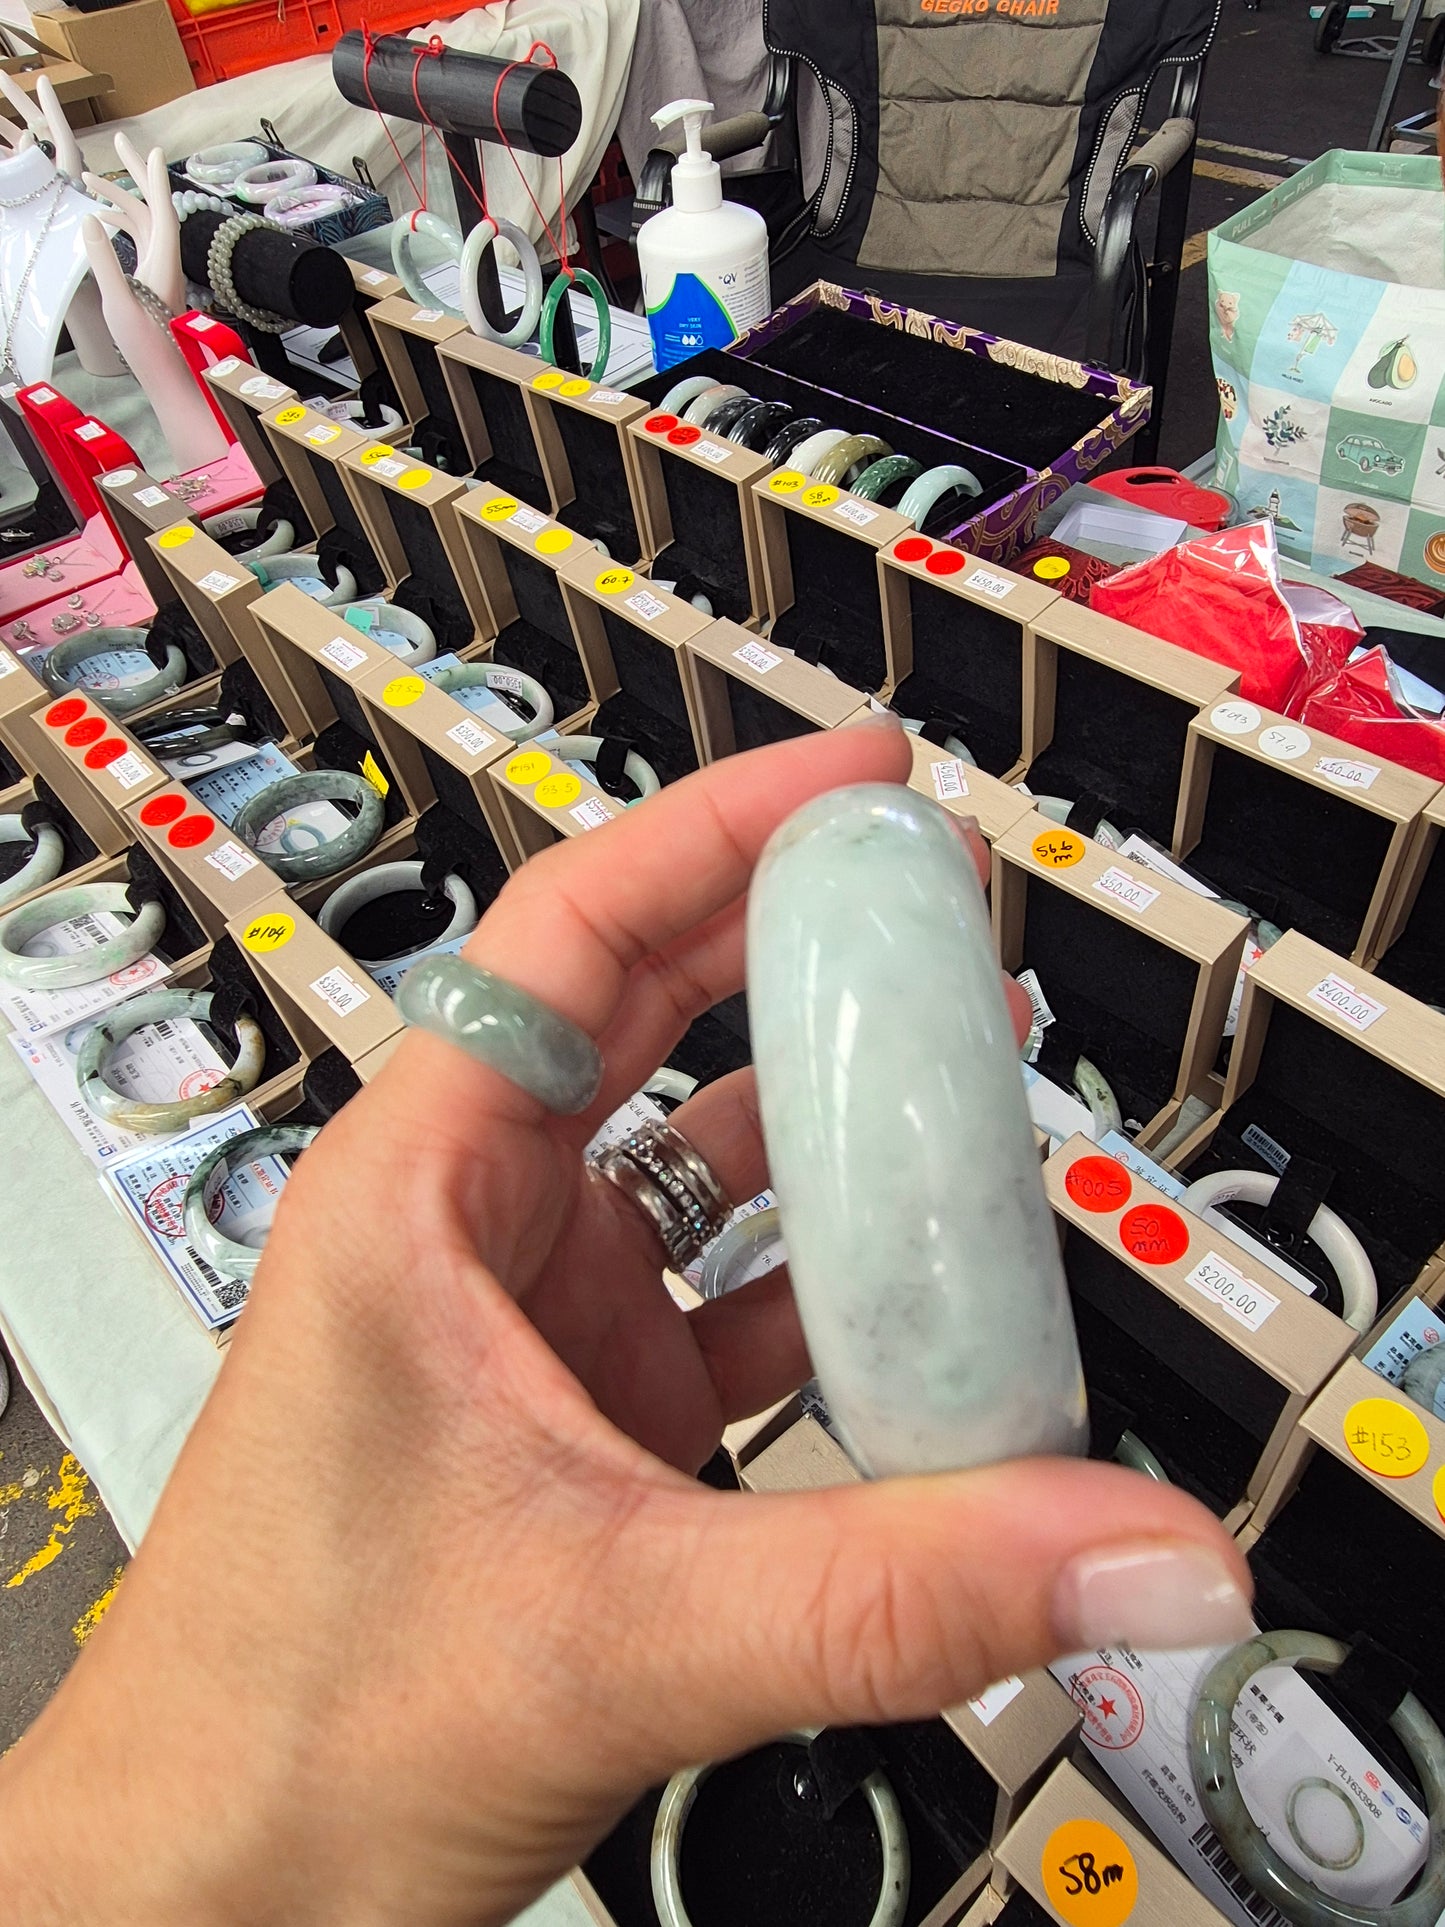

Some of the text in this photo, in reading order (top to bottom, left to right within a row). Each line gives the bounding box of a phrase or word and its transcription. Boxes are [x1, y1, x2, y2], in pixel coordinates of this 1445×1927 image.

[920, 0, 1059, 16] GECKO CHAIR
[1368, 397, 1393, 407] AVOCADO
[773, 479, 799, 489] #103
[455, 724, 486, 750] $350.00
[246, 925, 287, 943] #104
[319, 976, 353, 1009] $350.00
[1318, 978, 1370, 1020] $400.00
[1066, 1171, 1123, 1197] #005
[1129, 1217, 1160, 1238] 50
[1198, 1264, 1258, 1315] $200.00
[1351, 1425, 1412, 1461] #153
